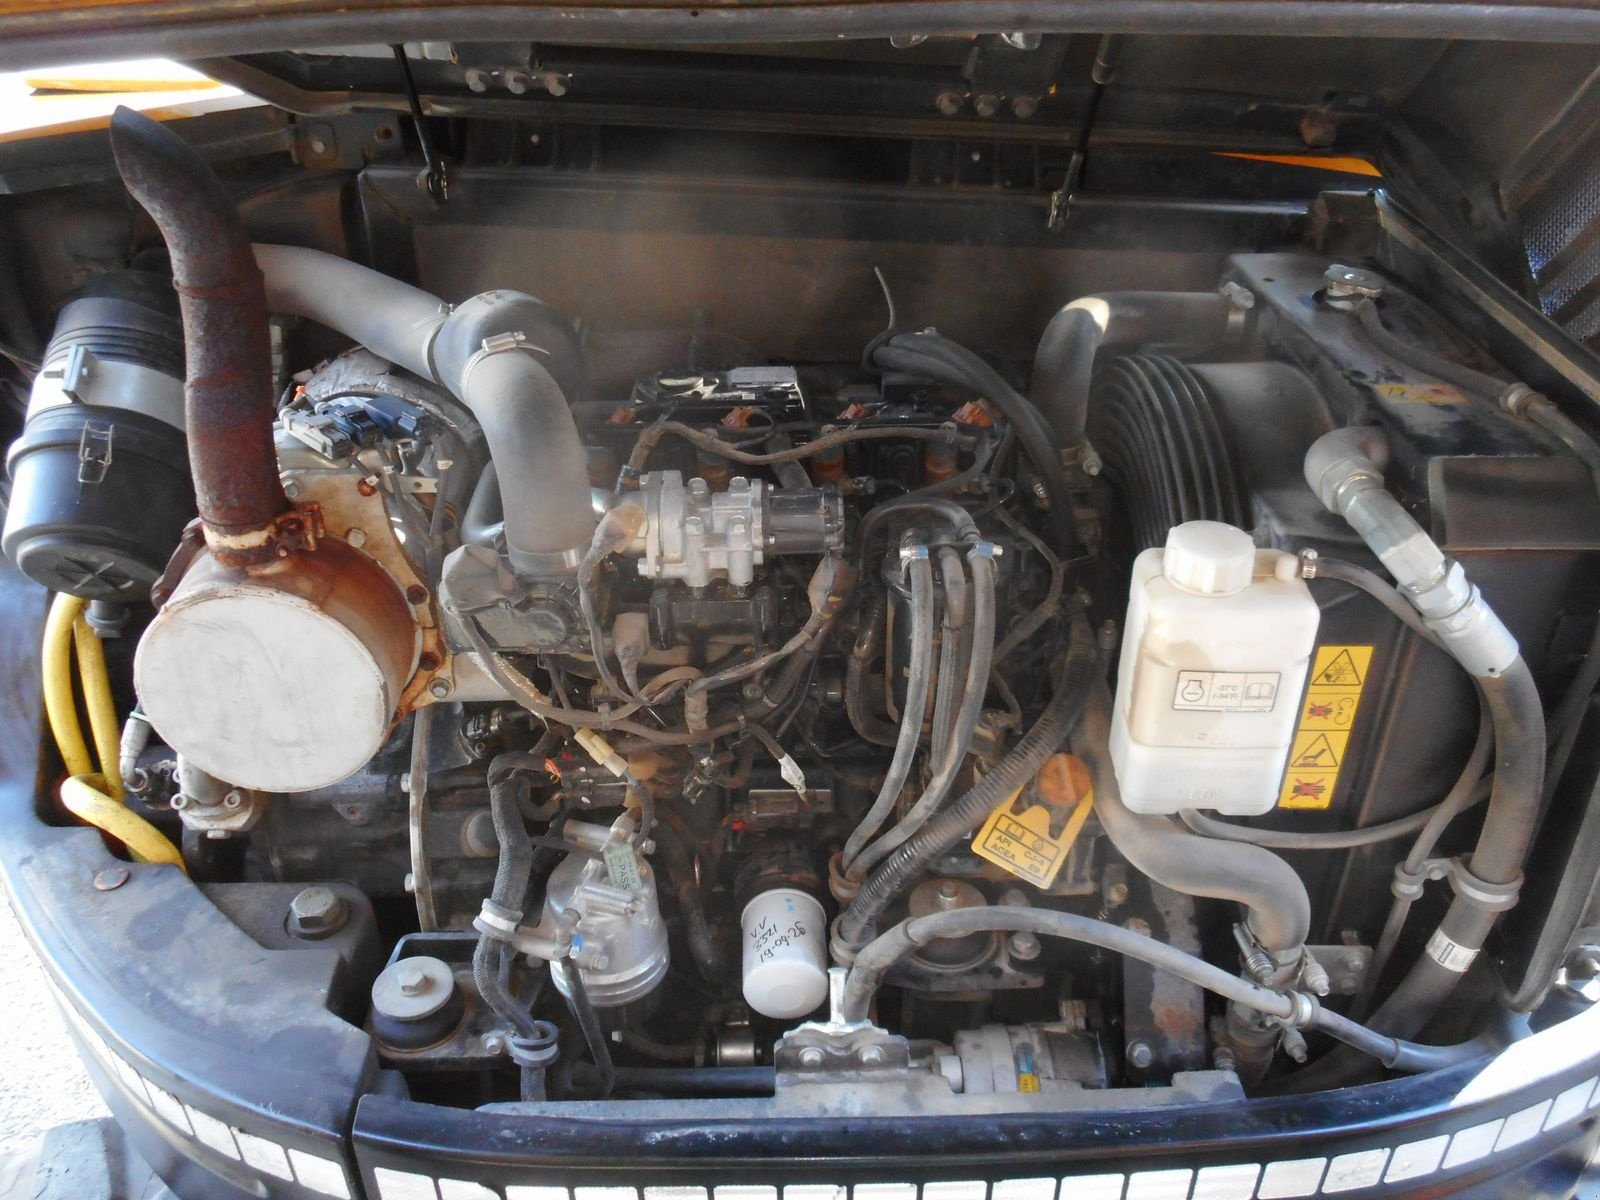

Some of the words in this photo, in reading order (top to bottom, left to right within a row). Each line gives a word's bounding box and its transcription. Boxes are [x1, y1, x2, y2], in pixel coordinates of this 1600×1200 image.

[996, 835, 1011, 847] API
[991, 844, 1015, 861] ACEA
[619, 864, 630, 889] PASS
